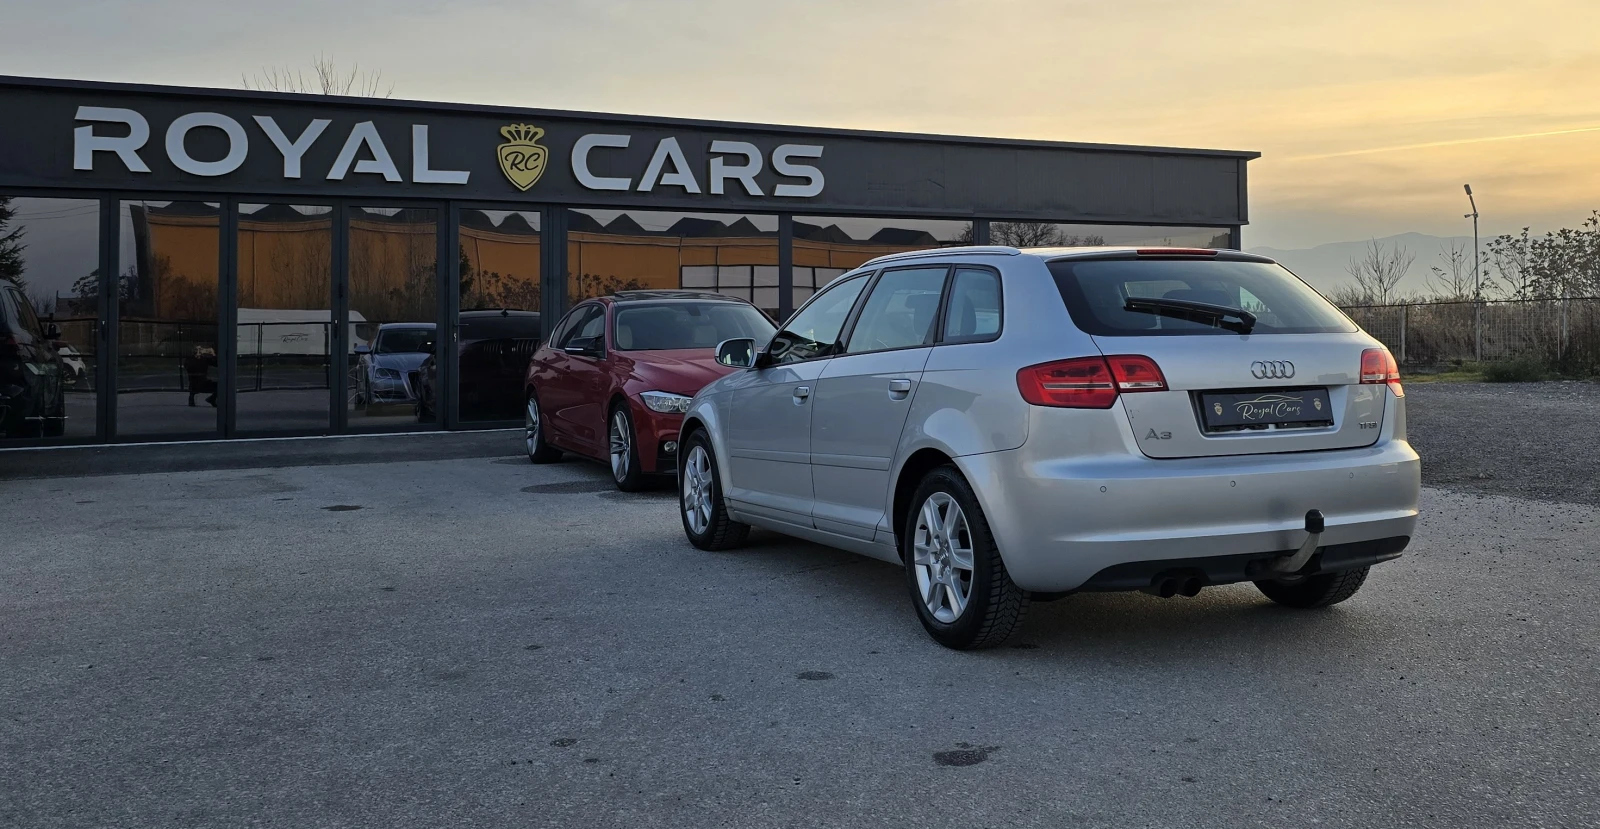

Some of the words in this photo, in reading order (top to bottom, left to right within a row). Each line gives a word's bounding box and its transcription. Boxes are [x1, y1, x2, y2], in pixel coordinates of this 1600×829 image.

[74, 106, 470, 184] ROYAL
[504, 150, 541, 172] RC
[572, 134, 824, 196] CARS
[1236, 403, 1273, 420] Royal
[1275, 402, 1301, 417] Cars
[1144, 427, 1173, 441] A3
